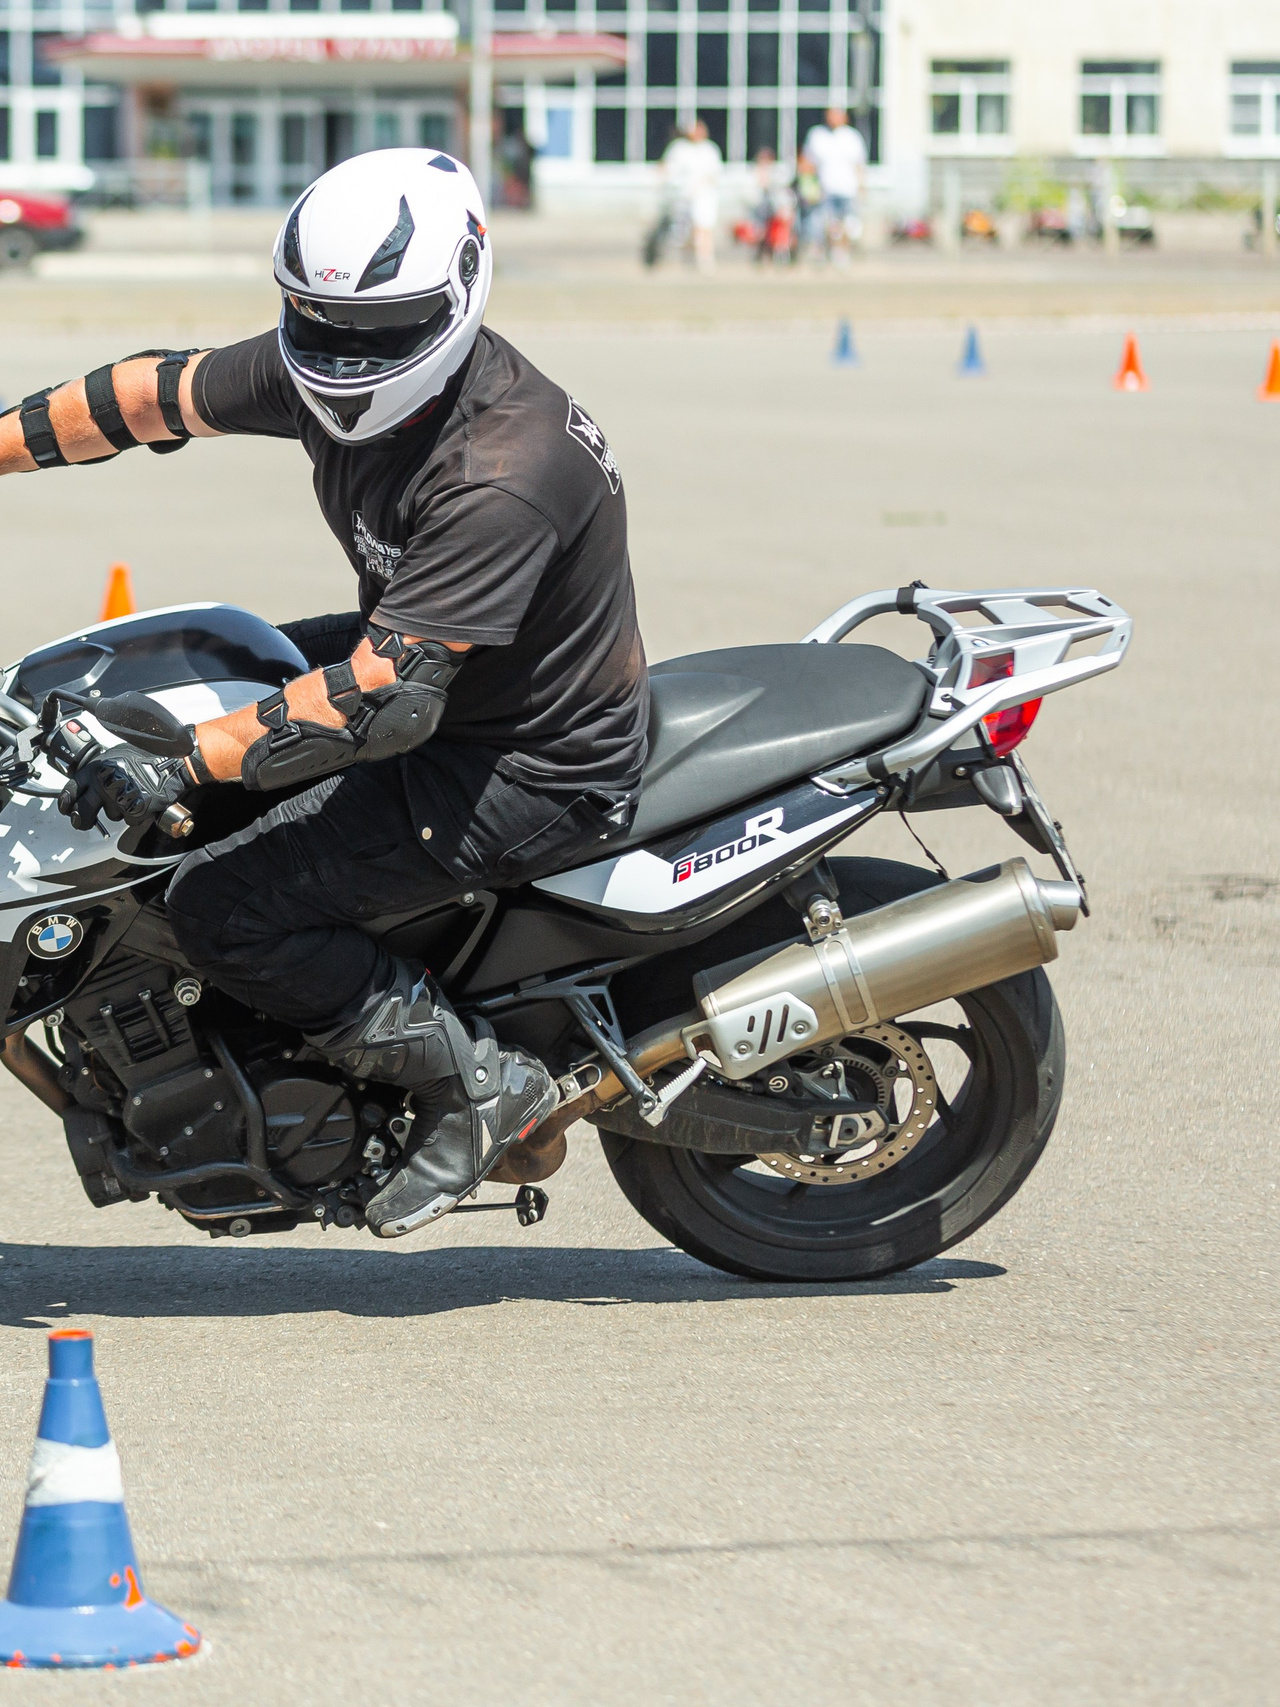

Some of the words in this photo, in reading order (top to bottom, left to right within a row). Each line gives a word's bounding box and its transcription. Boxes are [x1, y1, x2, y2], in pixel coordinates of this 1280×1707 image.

[314, 268, 351, 282] HIZER
[671, 806, 786, 885] F800R
[31, 916, 77, 936] BMW
